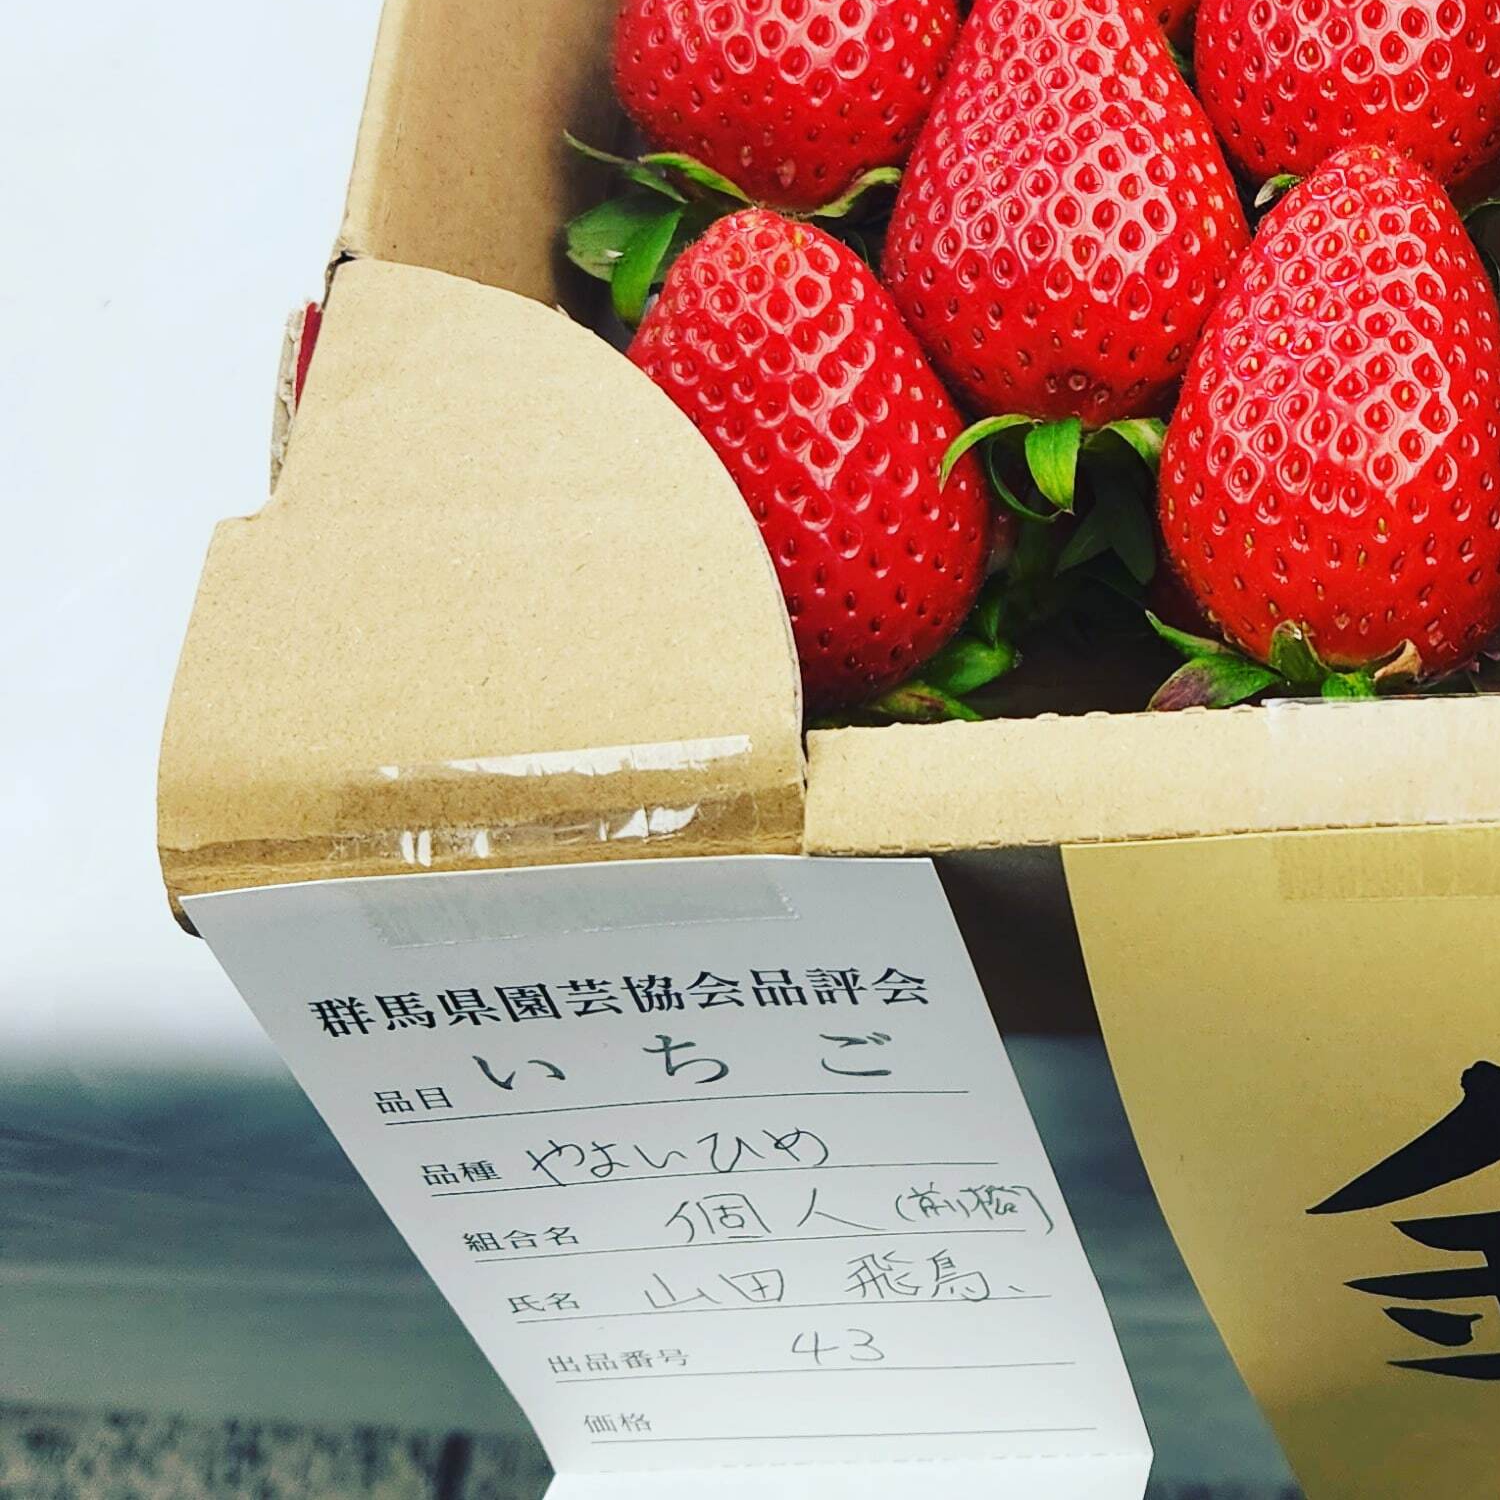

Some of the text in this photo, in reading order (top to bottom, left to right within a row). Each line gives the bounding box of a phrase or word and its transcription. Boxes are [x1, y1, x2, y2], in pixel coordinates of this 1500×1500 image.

[310, 967, 930, 1039] 群馬県園芸協会品評会
[374, 1031, 893, 1115] 品目 いちご
[420, 1126, 830, 1188] 品種 やよいひめ
[462, 1225, 580, 1254] 組合名
[506, 1291, 581, 1315] 氏名
[547, 1328, 886, 1376] 出品番号 43
[583, 1412, 654, 1436] 価格
